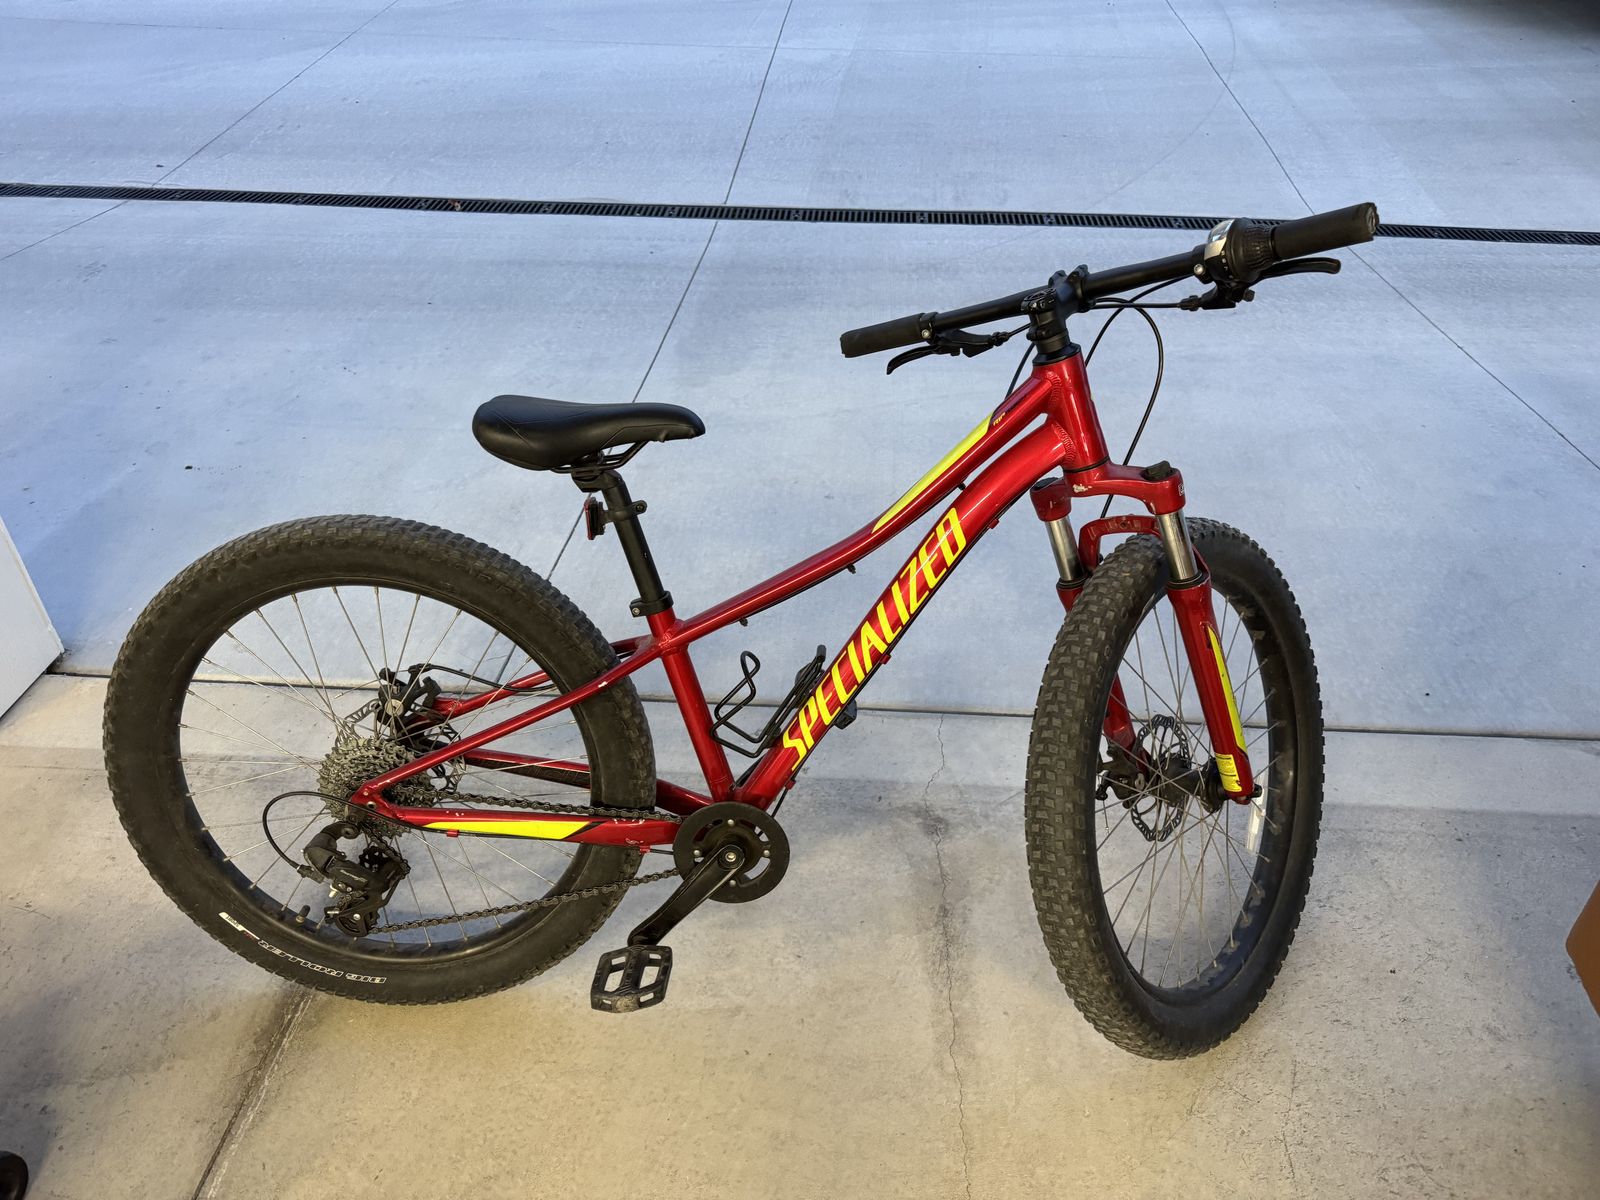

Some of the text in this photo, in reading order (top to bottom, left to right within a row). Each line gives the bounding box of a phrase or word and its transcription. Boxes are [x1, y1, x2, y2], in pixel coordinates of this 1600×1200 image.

[783, 507, 967, 771] SPECIALIZED
[257, 939, 344, 978] ROLLER
[345, 972, 387, 984] BIG
